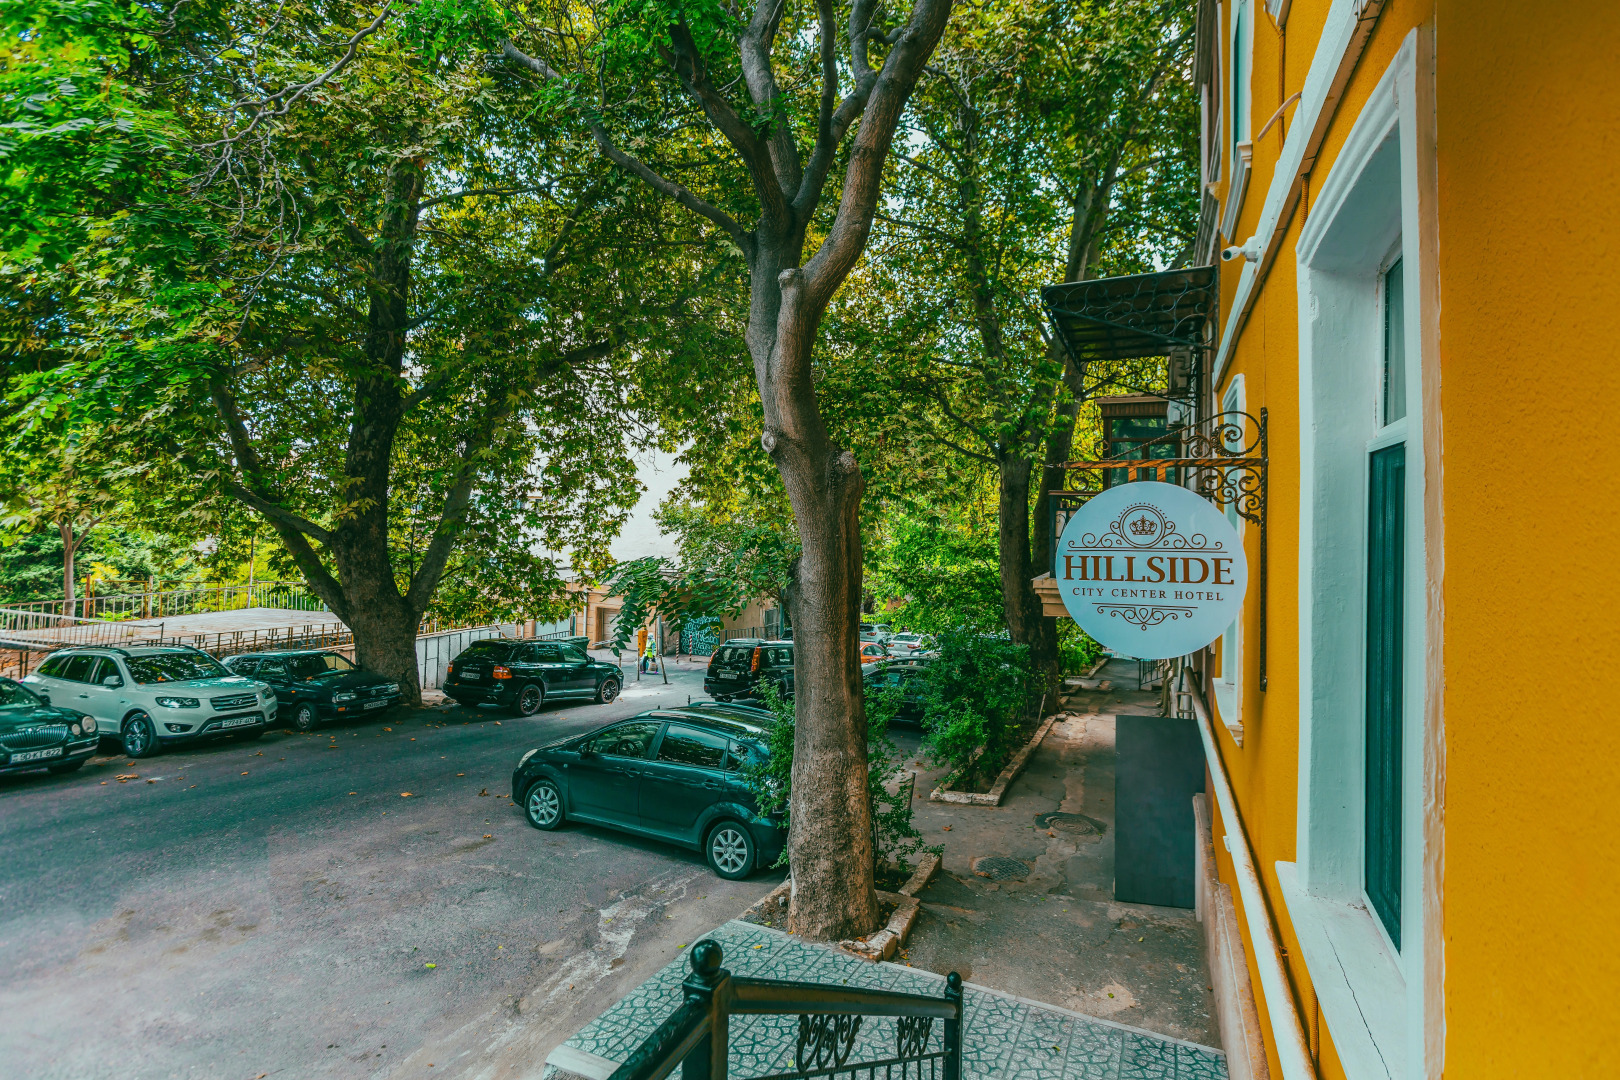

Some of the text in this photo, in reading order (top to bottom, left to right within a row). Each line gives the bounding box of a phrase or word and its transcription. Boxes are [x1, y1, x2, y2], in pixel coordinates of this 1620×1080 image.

[1063, 555, 1235, 585] HILLSIDE
[1072, 587, 1224, 602] CITY CENTER HOTEL
